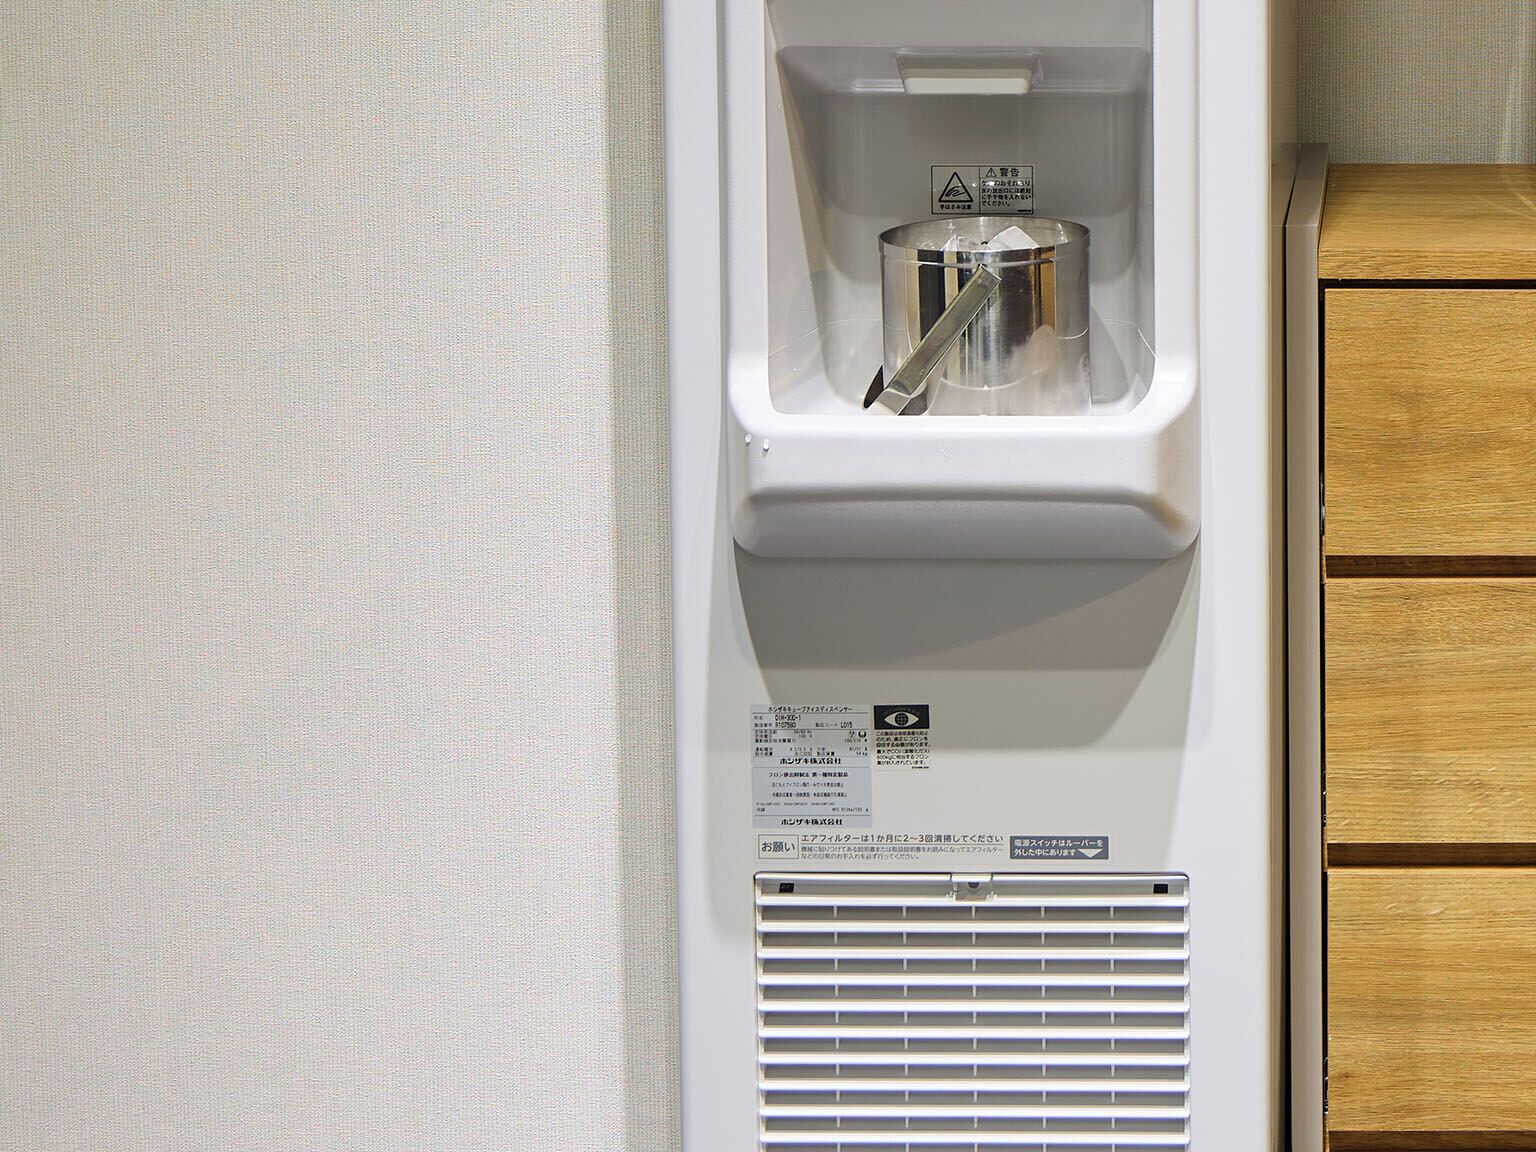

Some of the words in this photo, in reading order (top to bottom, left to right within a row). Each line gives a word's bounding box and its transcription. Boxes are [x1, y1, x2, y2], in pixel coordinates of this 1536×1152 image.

[761, 841, 796, 853] お願い
[1014, 839, 1104, 847] 電源スイッチはルーバーを
[1014, 848, 1076, 857] 外した中にあります
